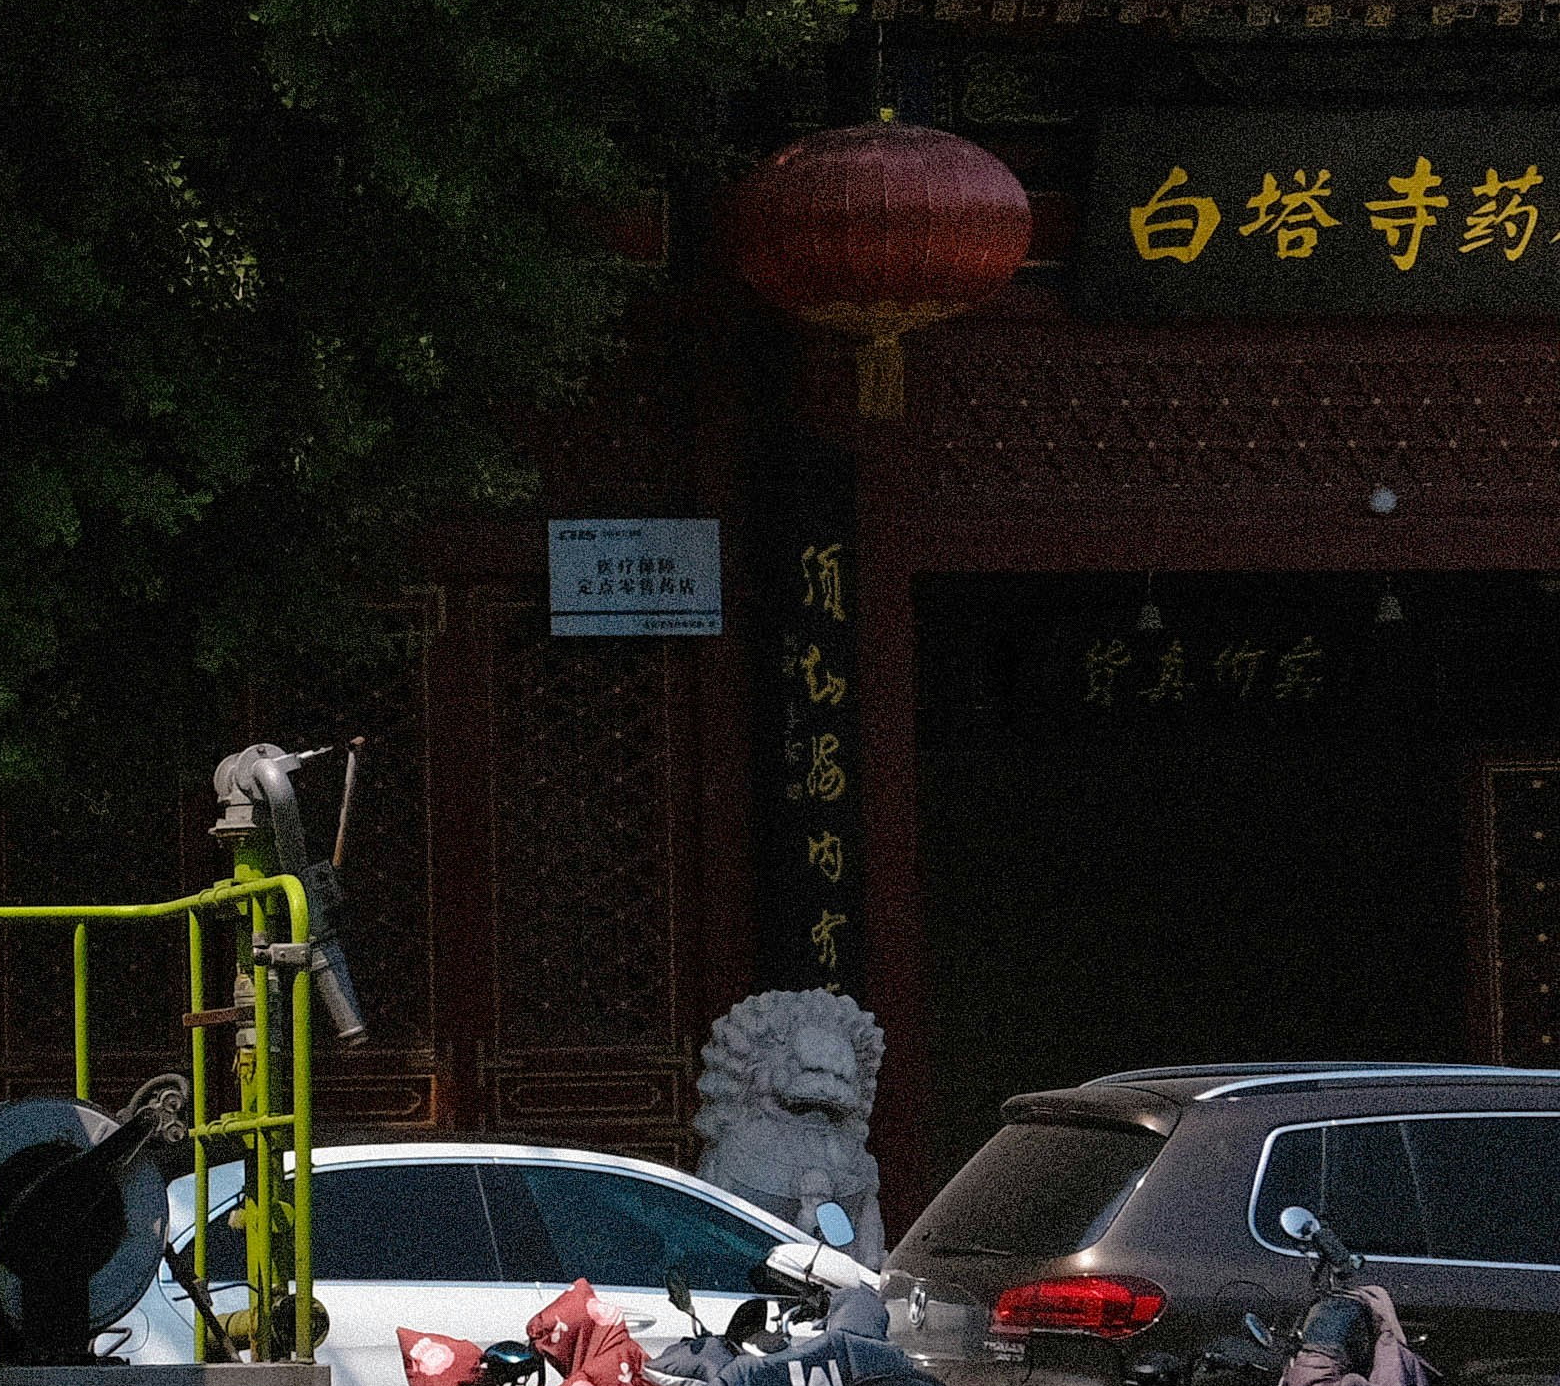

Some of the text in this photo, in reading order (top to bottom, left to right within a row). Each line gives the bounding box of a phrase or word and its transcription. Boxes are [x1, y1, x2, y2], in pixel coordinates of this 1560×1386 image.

[1128, 154, 1560, 272] 白塔寺药
[577, 577, 696, 596] 定点零售药店
